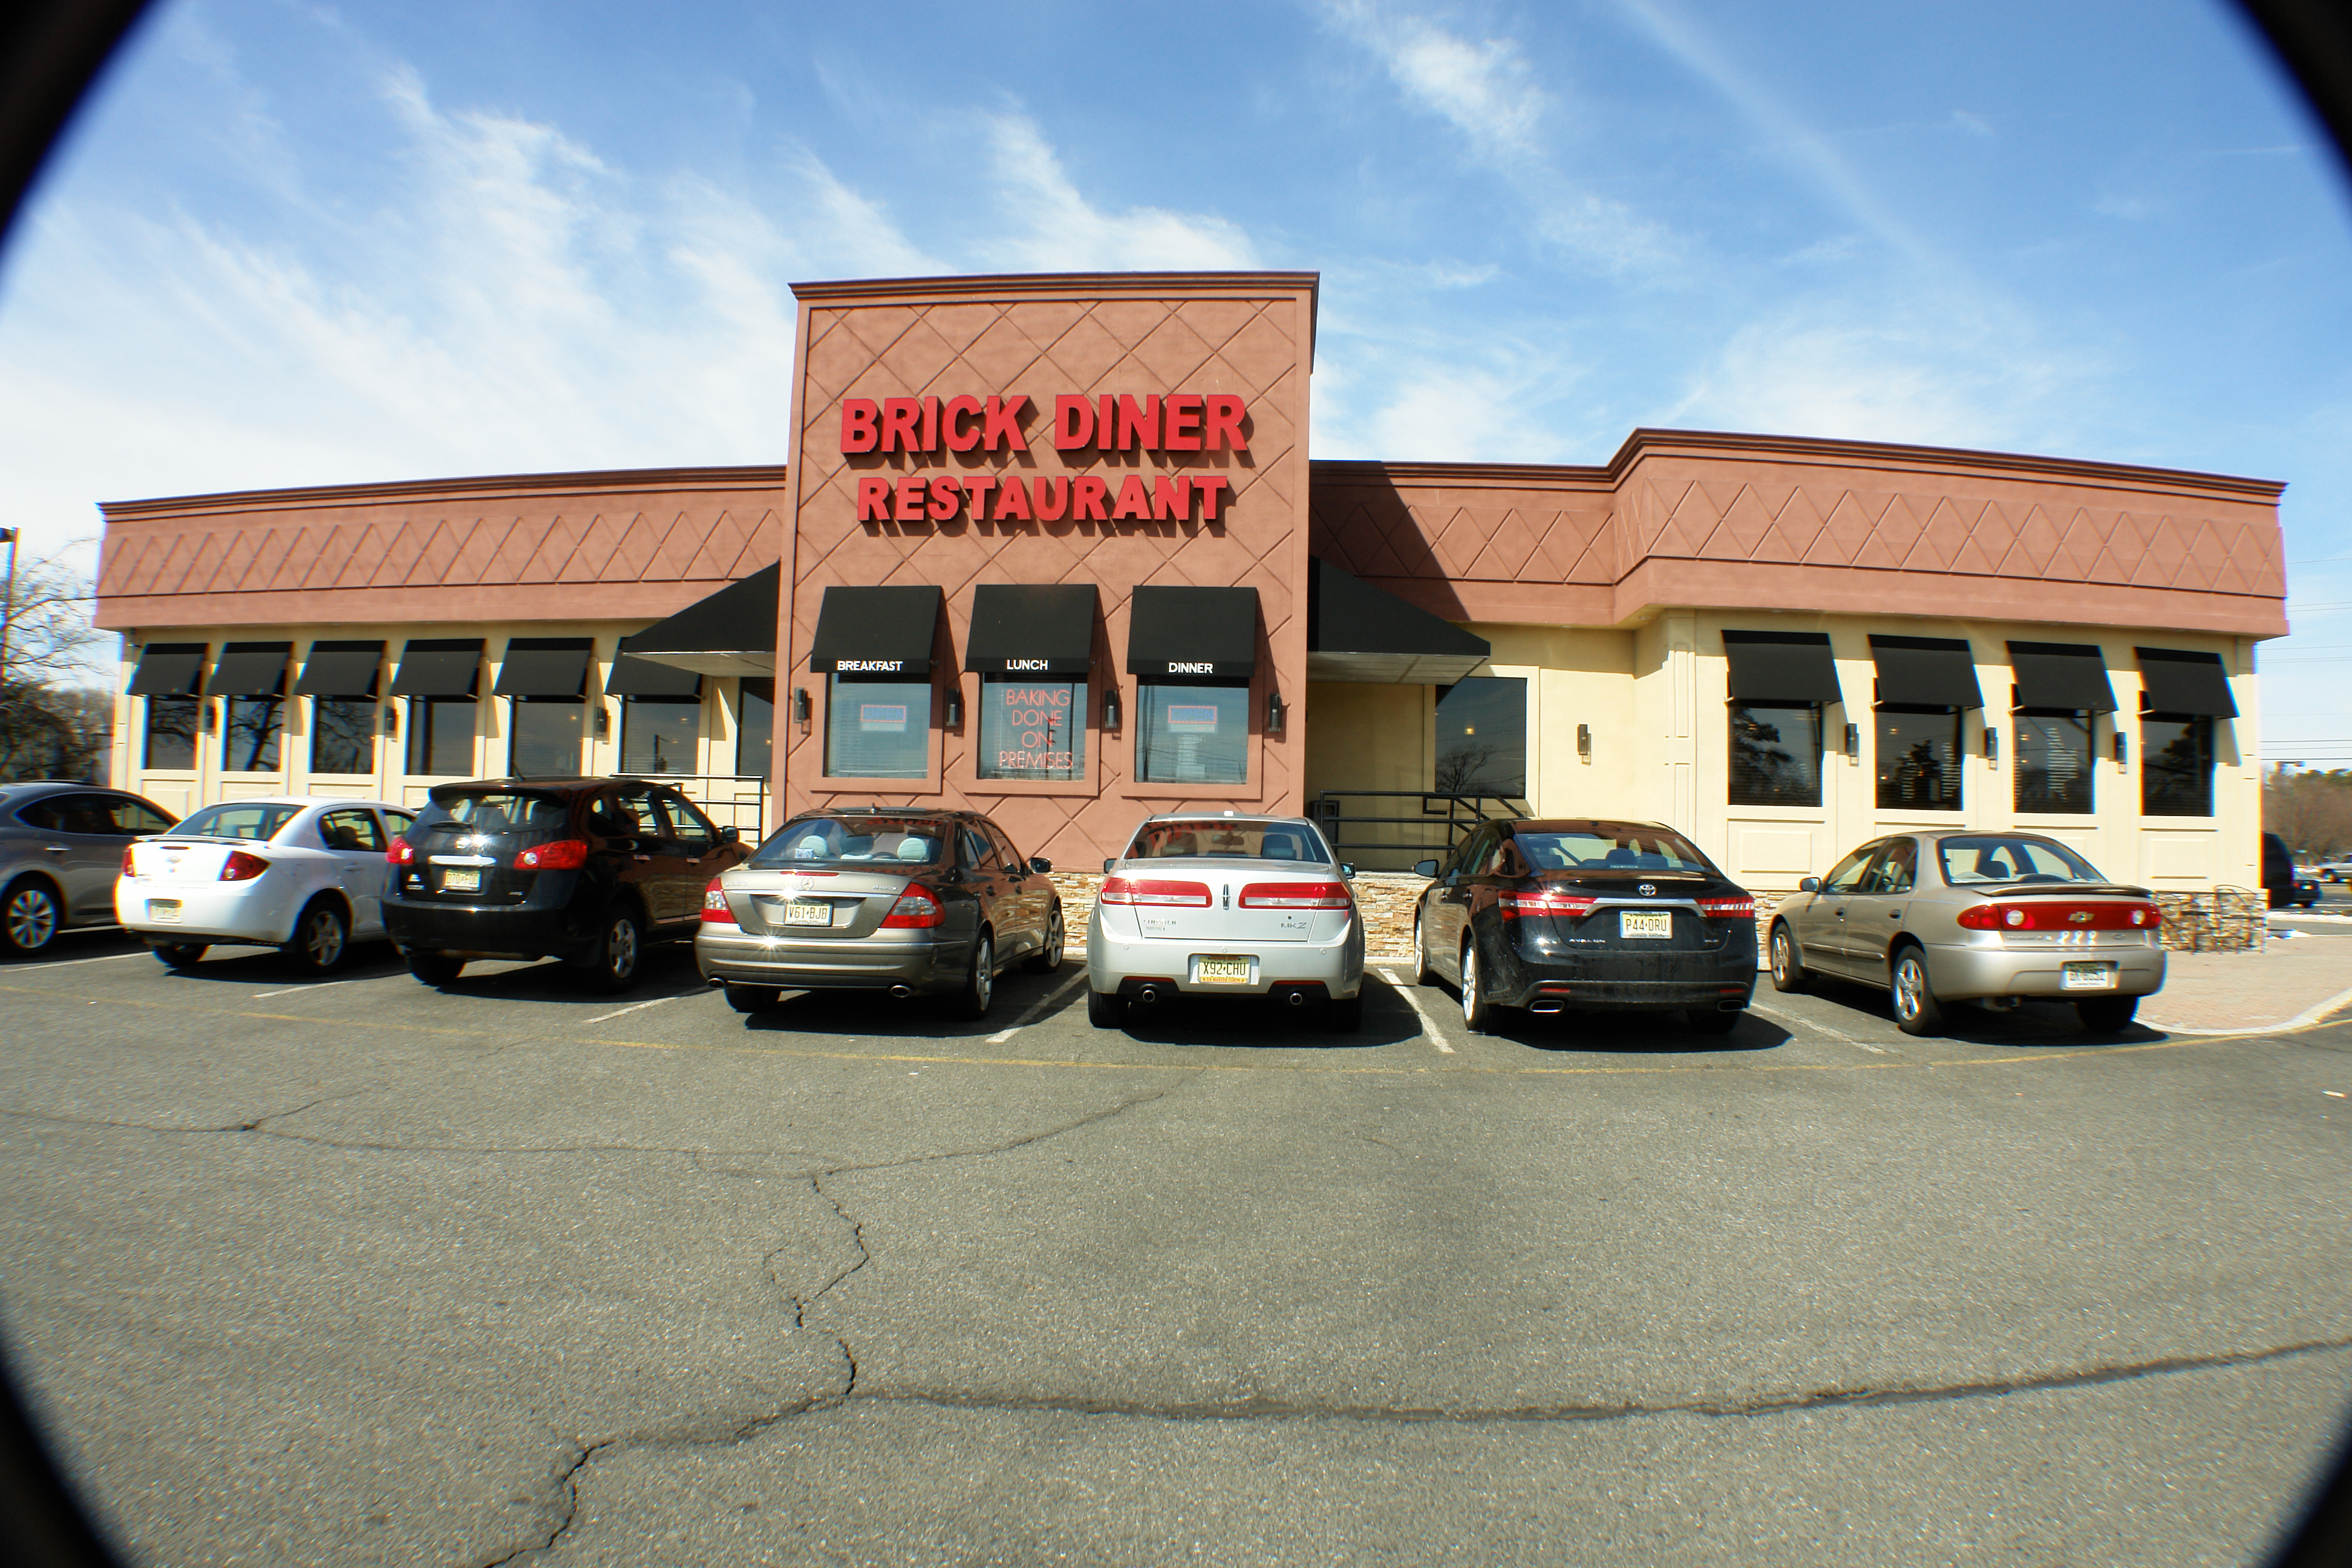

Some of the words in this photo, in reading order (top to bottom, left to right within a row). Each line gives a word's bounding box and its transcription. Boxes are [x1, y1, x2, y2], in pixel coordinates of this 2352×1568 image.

[841, 394, 1030, 453] BRICK
[1054, 394, 1248, 451] DINER
[857, 474, 1227, 521] RESTAURANT
[837, 660, 903, 671] BREAKFAST
[1007, 659, 1048, 670] LUNCH
[1168, 662, 1214, 674] DINNER
[1006, 689, 1070, 707] BAKING
[864, 707, 905, 720] OPEN
[1011, 709, 1062, 727] DONE
[1171, 708, 1215, 722] OPEN
[1022, 731, 1053, 748] ON
[999, 750, 1073, 769] PREMISES
